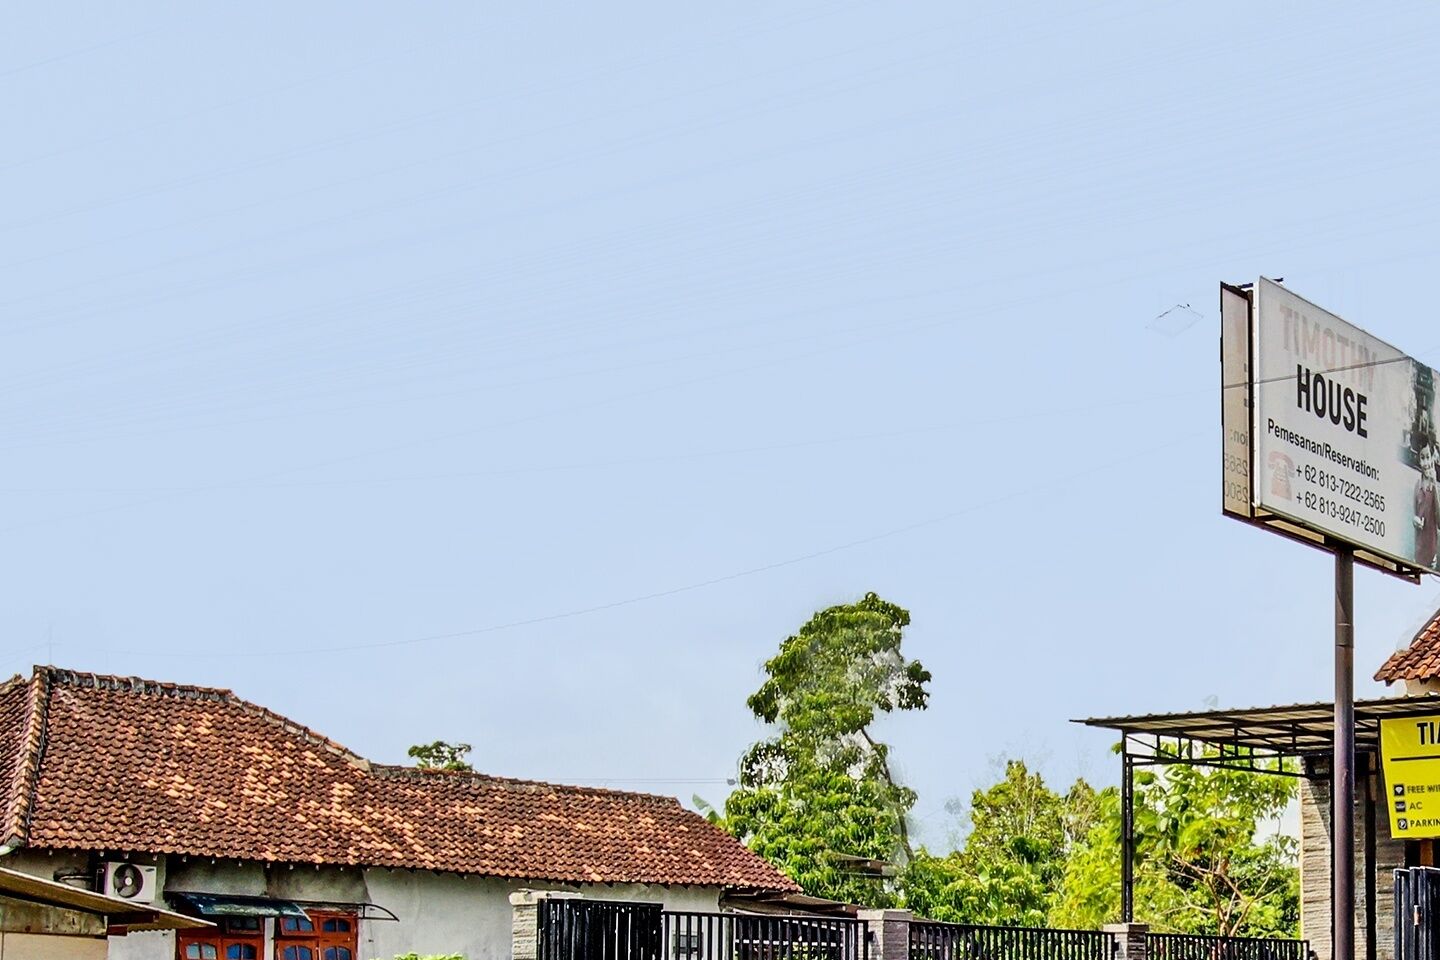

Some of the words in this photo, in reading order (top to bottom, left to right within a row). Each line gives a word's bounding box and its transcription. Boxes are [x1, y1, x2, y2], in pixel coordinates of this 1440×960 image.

[1297, 363, 1368, 440] HOUSE
[1267, 418, 1380, 481] Pemesanan/Reservation:
[1304, 464, 1317, 484] 62
[1318, 470, 1386, 512] 813-7222-2565
[1304, 491, 1317, 511] 62
[1318, 497, 1386, 538] 813-9247-2500
[1407, 785, 1425, 793] FREE
[1409, 801, 1423, 810] AC
